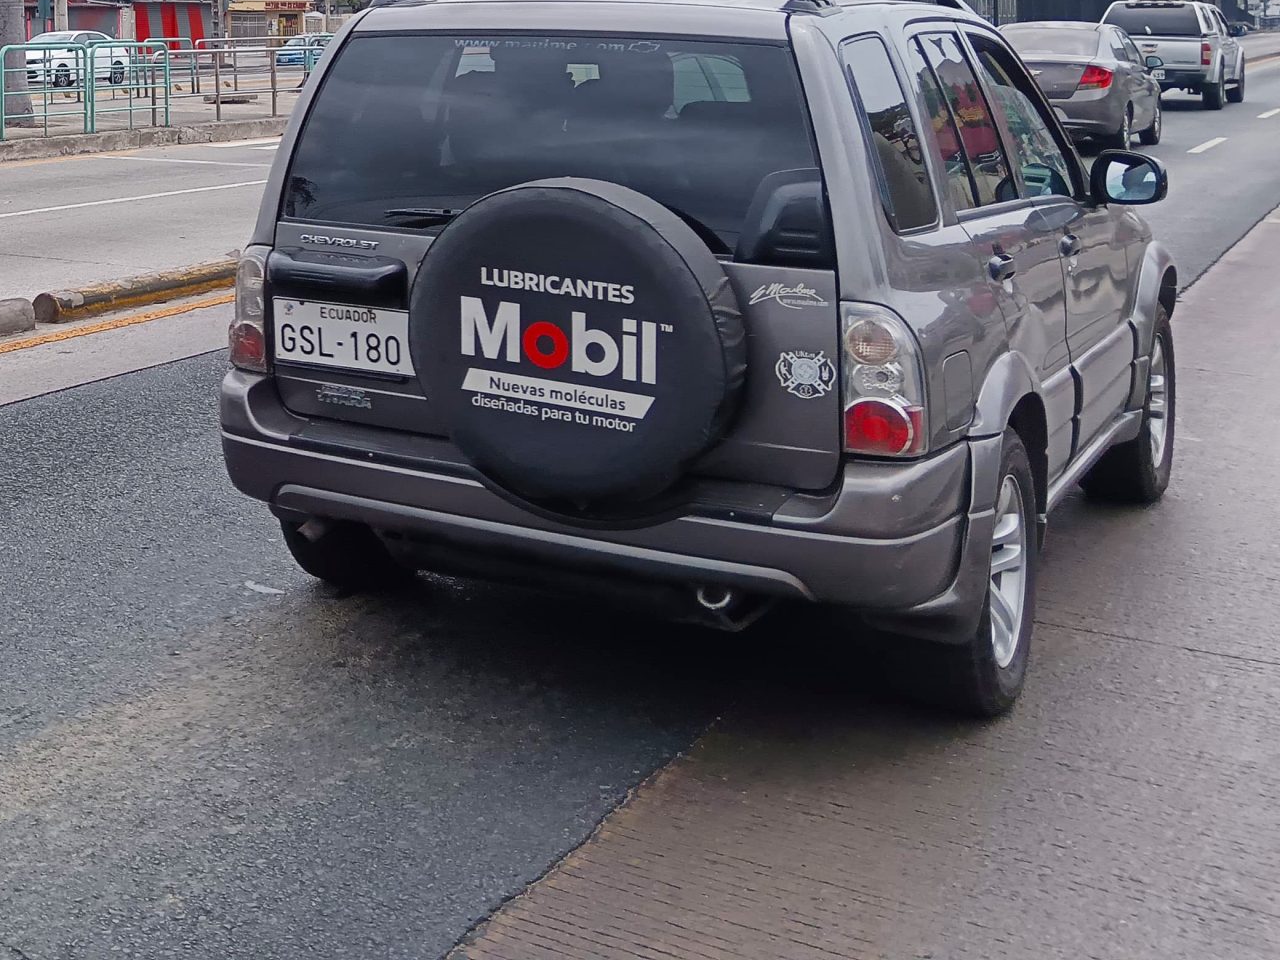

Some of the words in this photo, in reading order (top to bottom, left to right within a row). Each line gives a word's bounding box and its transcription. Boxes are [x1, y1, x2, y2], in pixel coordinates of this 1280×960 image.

[300, 234, 380, 250] CHEVROLET
[480, 266, 635, 305] LUBRICANTES
[320, 306, 377, 324] ECUADOR
[281, 323, 400, 366] GSL-180
[489, 376, 545, 398] Nuevas
[549, 390, 626, 411] moléculas
[471, 393, 539, 417] diseñadas
[541, 406, 572, 421] para
[575, 411, 589, 424] tu
[592, 415, 636, 432] motor
